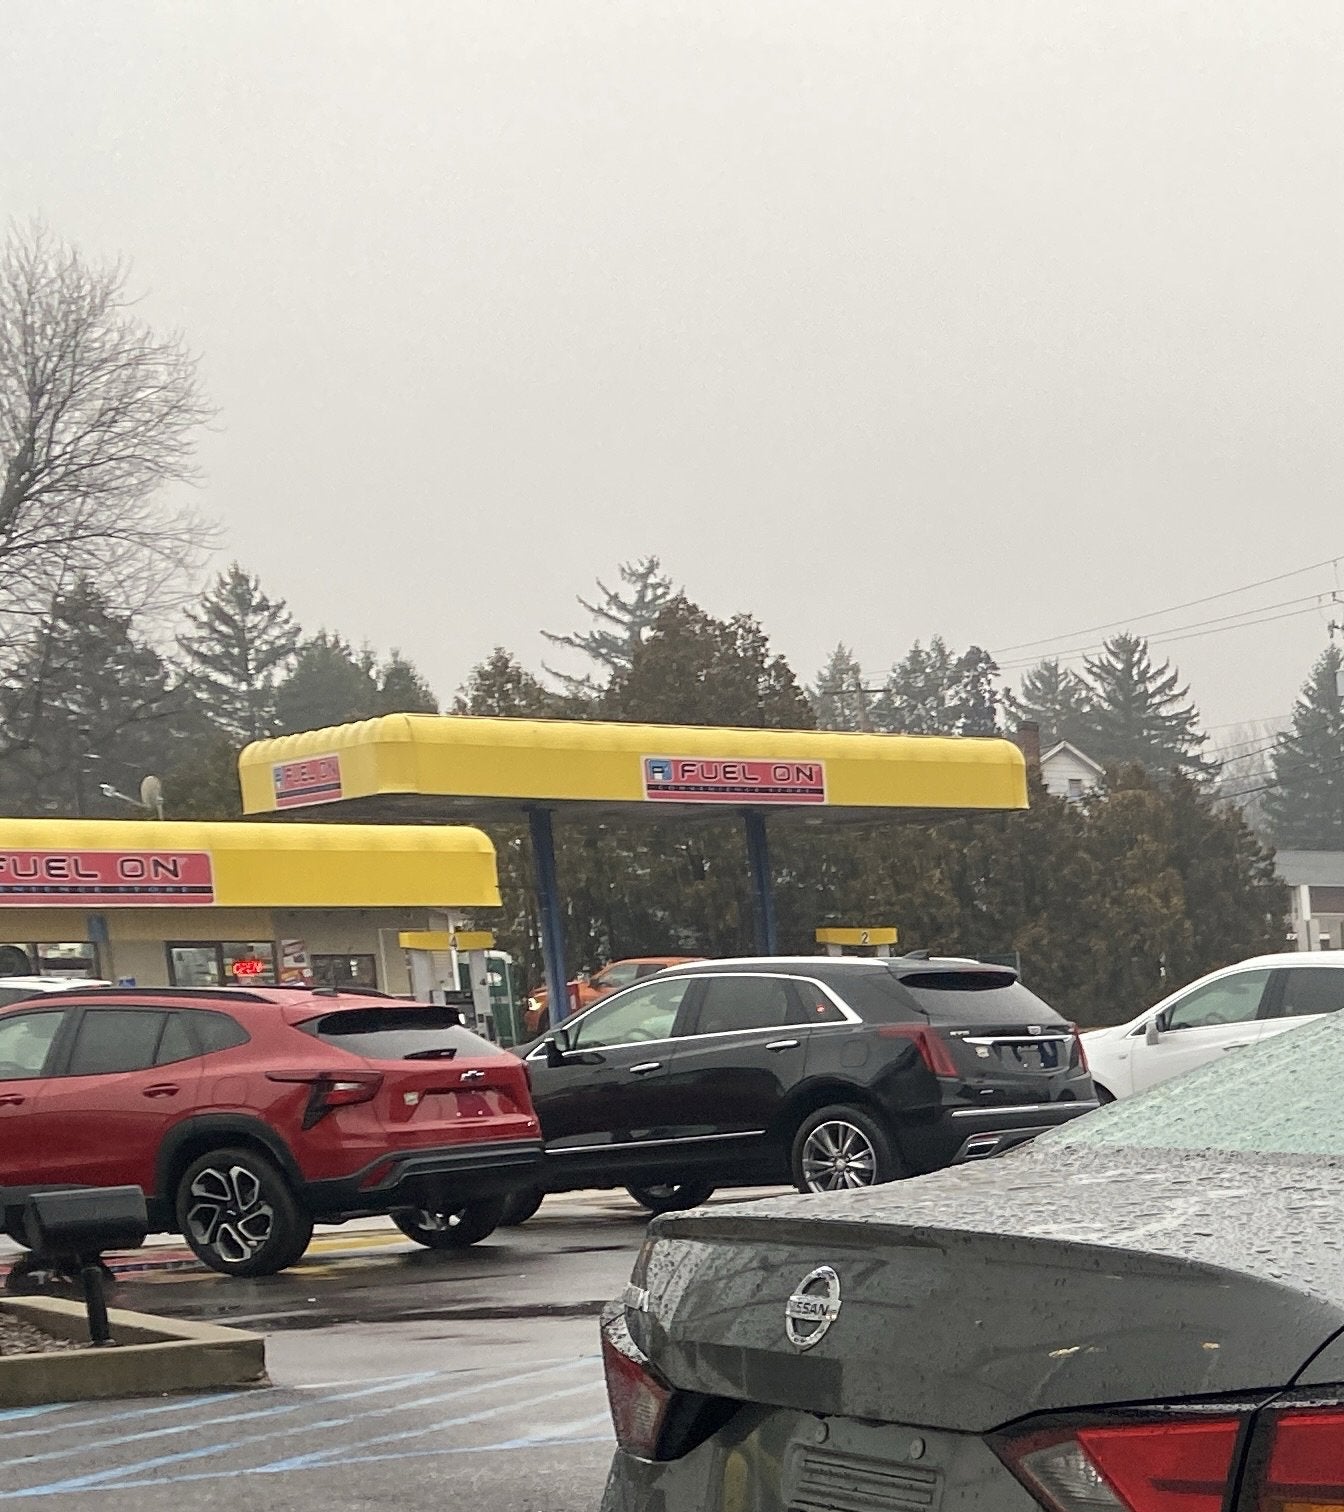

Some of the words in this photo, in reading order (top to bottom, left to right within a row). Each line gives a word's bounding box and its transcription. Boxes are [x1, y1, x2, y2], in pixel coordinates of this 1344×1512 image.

[680, 762, 760, 782] FUEL
[772, 764, 815, 783] ON
[119, 858, 182, 879] ON
[861, 931, 869, 945] 2
